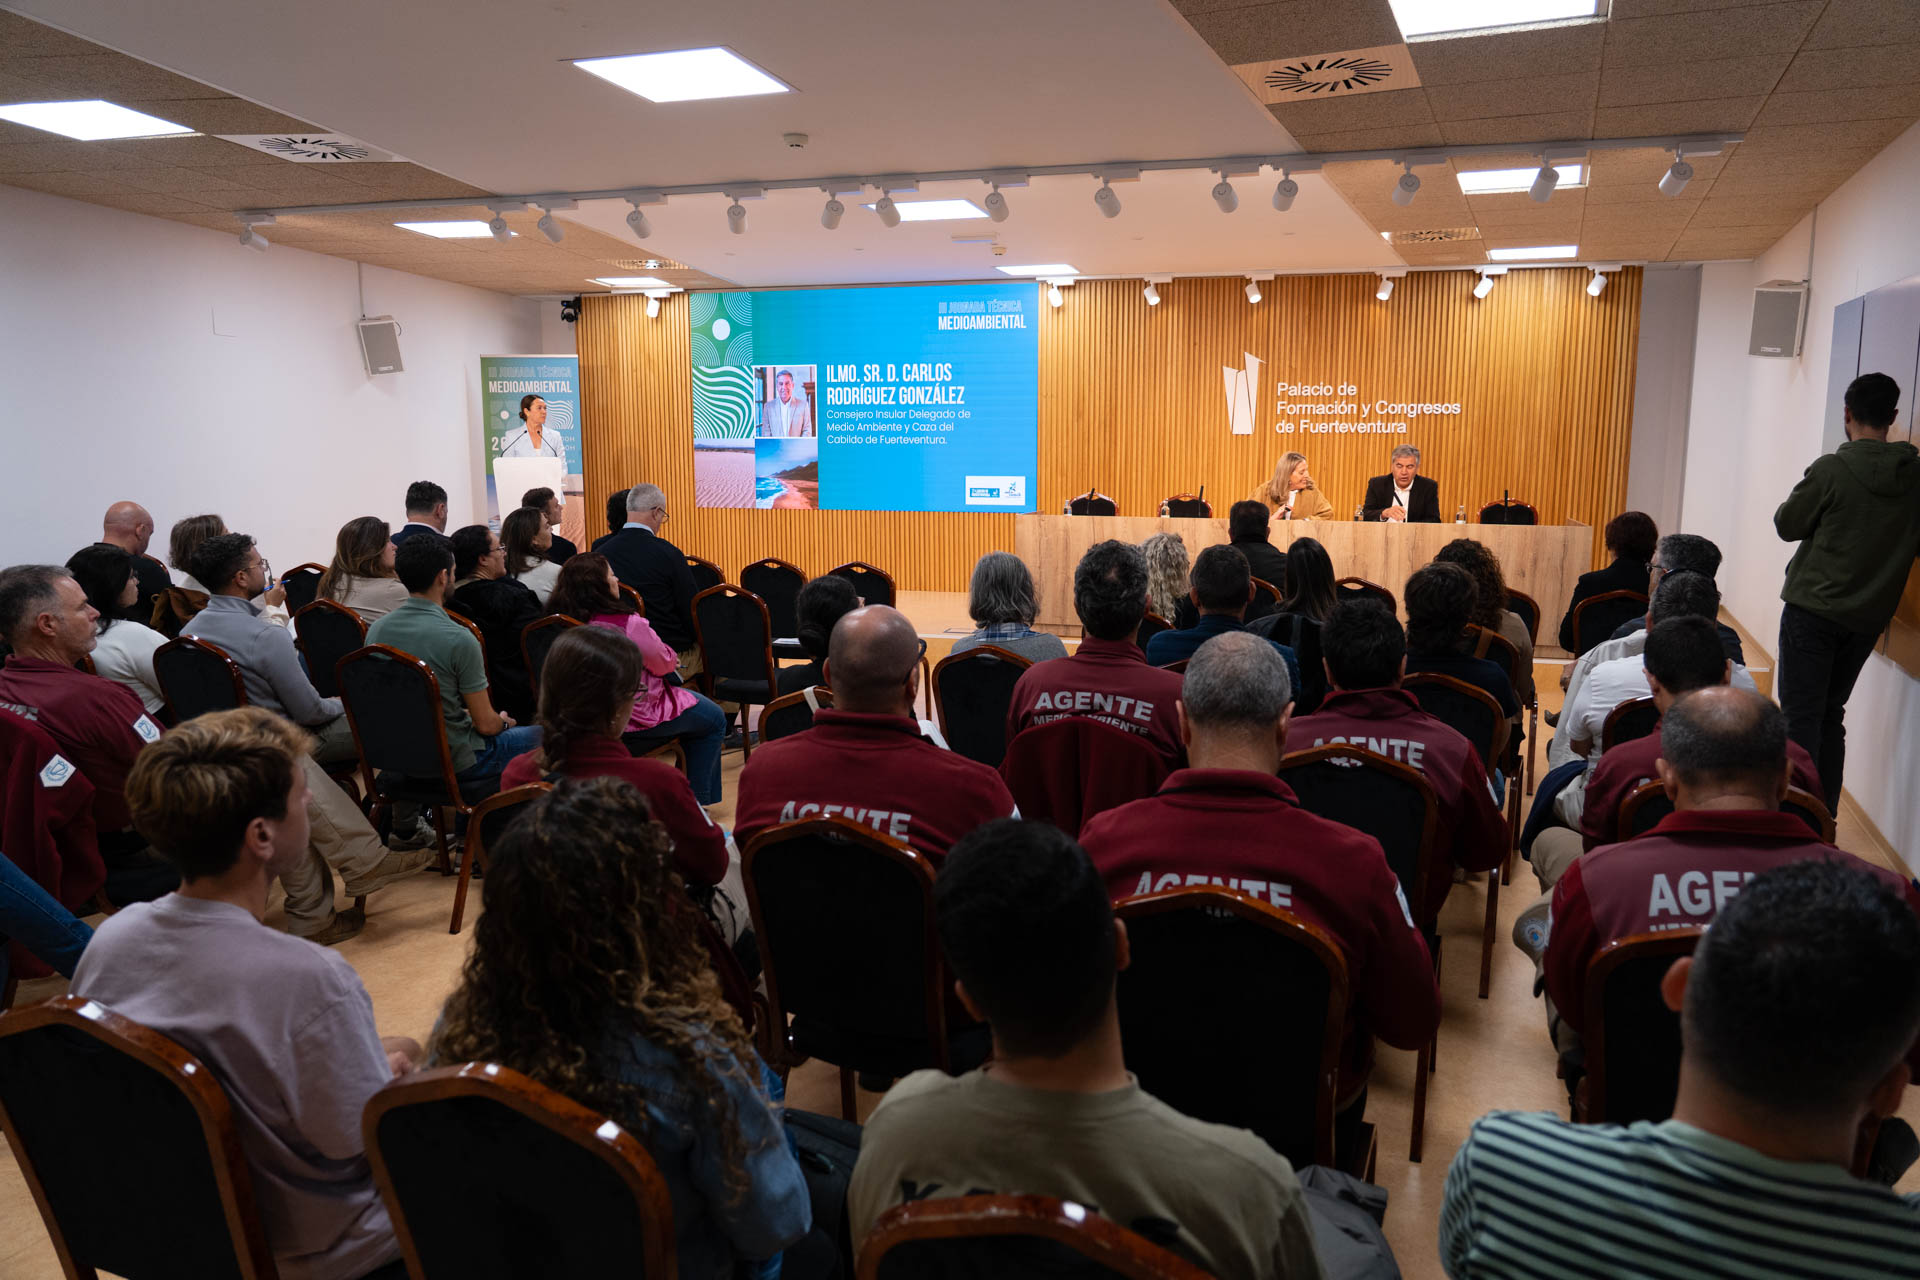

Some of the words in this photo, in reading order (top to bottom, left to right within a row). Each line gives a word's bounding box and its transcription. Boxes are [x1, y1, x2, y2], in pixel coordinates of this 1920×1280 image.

[949, 301, 985, 314] JORNADA
[987, 299, 1022, 313] TÉCNICA
[938, 315, 1027, 330] MEDIOAMBIENTAL
[826, 364, 860, 383] ILMO.
[863, 364, 884, 382] SR.
[887, 364, 900, 382] D.
[902, 363, 953, 382] CARLOS
[488, 381, 573, 393] MEDIOAMBIENTAL
[827, 384, 896, 405] RODRÍGUEZ
[899, 383, 965, 405] GONZÁLEZ
[1277, 382, 1333, 397] Palacio
[1337, 381, 1357, 396] de
[826, 410, 874, 421] Consejero
[875, 410, 907, 419] Insular
[908, 409, 955, 421] Delegado
[958, 409, 971, 419] de
[1276, 400, 1357, 415] Formación
[1361, 402, 1372, 418] y
[1375, 400, 1461, 418] Congresos
[826, 422, 854, 431] Medio
[857, 421, 902, 432] Ambiente
[904, 424, 911, 433] y
[912, 422, 937, 432] Caza
[939, 421, 954, 432] del
[1275, 420, 1295, 434] de
[1299, 419, 1407, 434] Fuerteventura
[826, 434, 863, 445] Cabildo
[865, 433, 878, 444] de
[880, 434, 948, 445] Fuerteventura.
[1034, 690, 1154, 722] AGENTE
